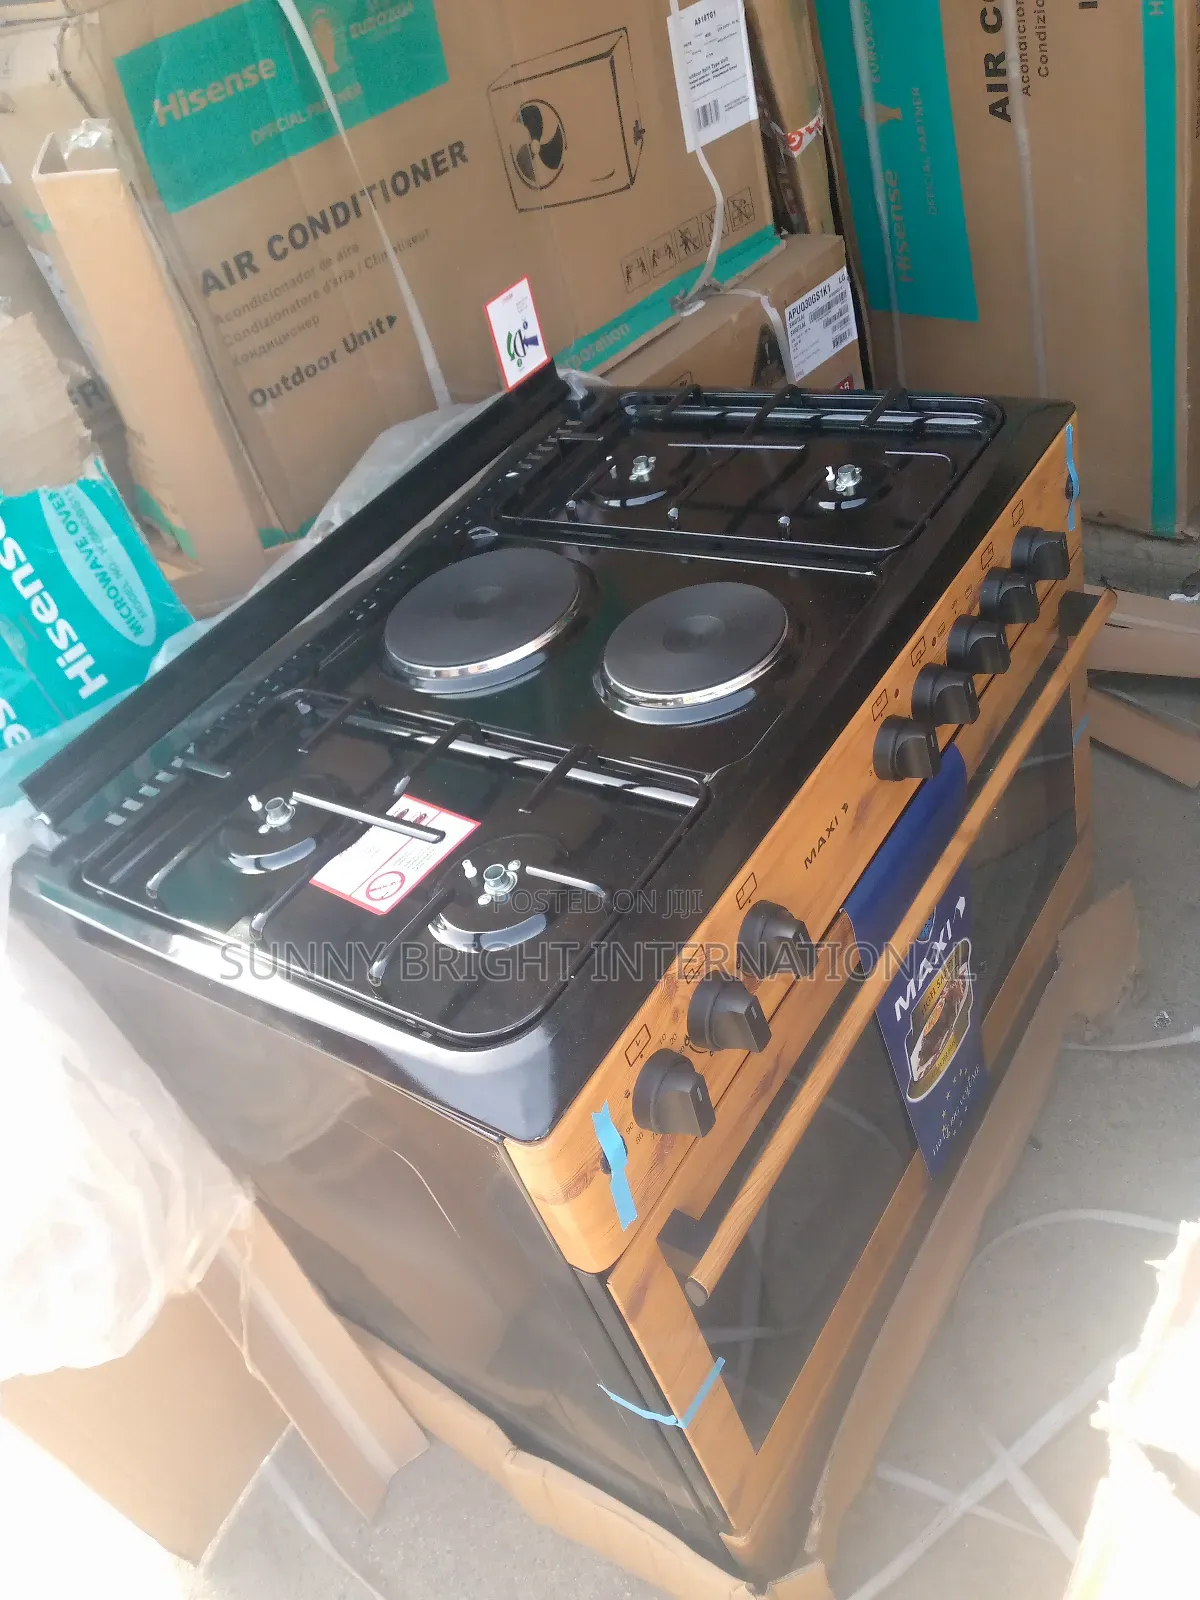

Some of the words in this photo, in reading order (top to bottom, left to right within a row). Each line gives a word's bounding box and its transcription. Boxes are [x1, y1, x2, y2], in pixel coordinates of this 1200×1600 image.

[153, 58, 278, 127] Hisense
[307, 83, 363, 119] PARNER
[984, 51, 1012, 123] AIR
[202, 250, 260, 297] AIR
[267, 140, 469, 261] CONDITIONER
[884, 169, 914, 282] Hisense
[214, 267, 316, 326] Acondicionador
[319, 256, 332, 271] de
[221, 290, 320, 348] Condizionatore
[249, 349, 339, 408] Outdoor
[342, 317, 387, 355] Unit
[75, 536, 145, 638] MICROWAVE
[804, 815, 839, 870] MAXI
[894, 919, 952, 1022] MAXI
